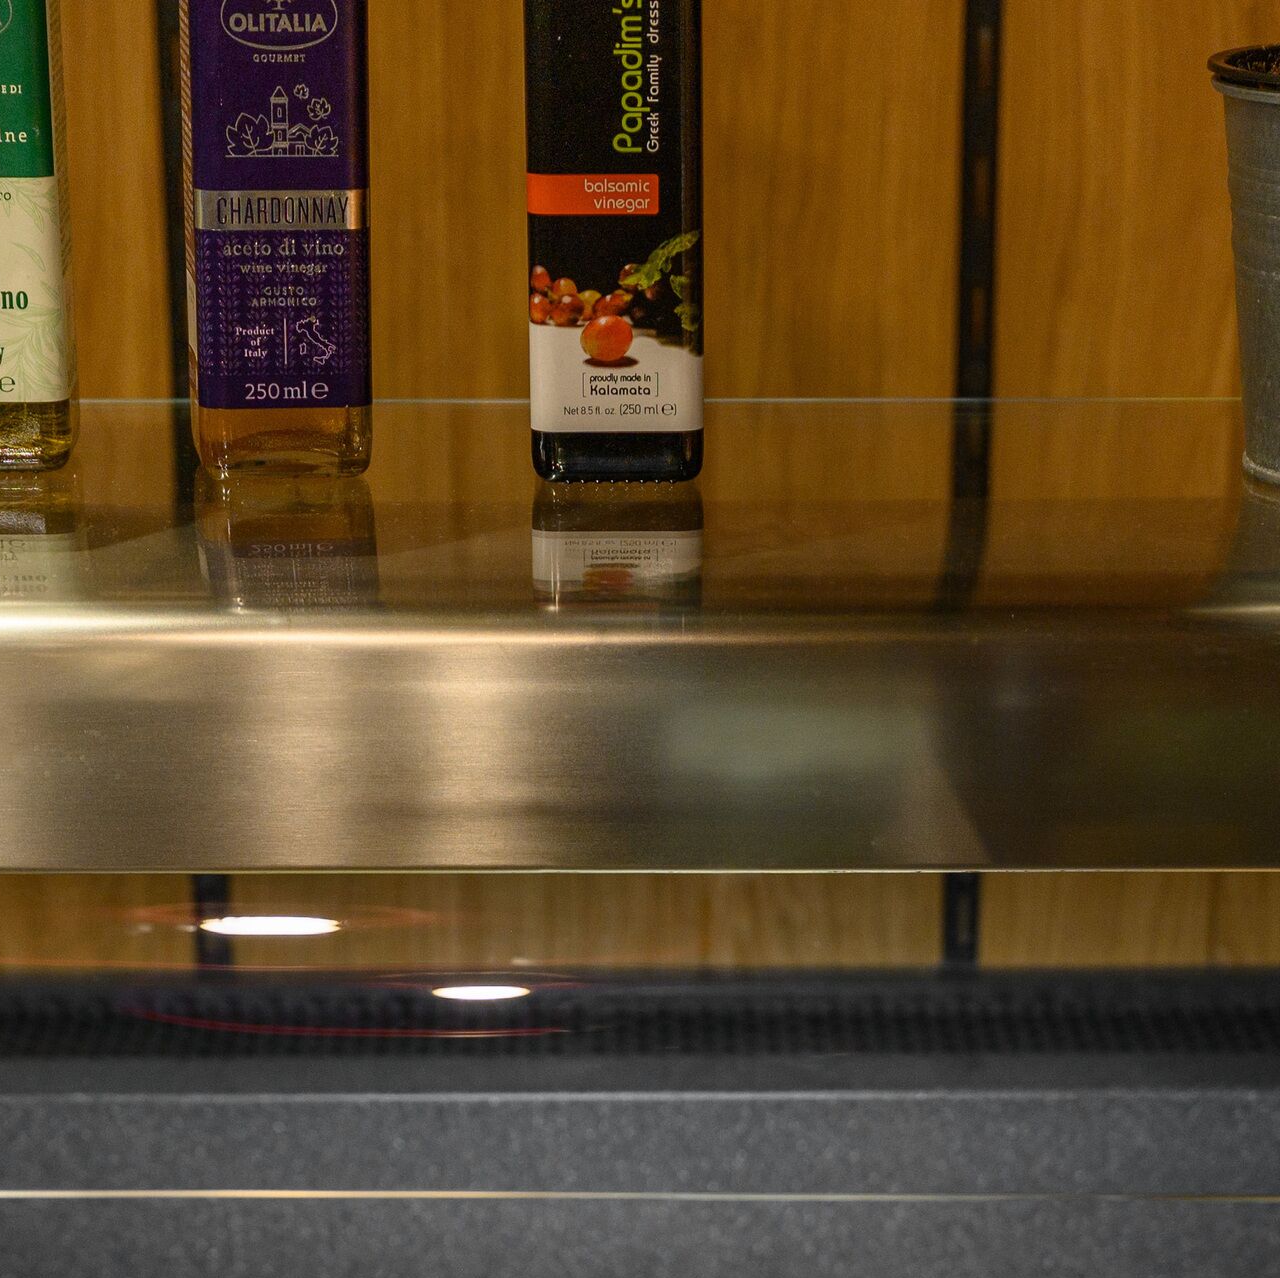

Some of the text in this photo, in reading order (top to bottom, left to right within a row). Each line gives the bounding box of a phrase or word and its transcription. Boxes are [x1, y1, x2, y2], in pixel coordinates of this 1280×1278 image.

[229, 13, 328, 33] OLITALIA
[253, 54, 306, 63] GOURMET
[612, 0, 650, 153] Papadim's
[647, 55, 663, 102] family
[10, 85, 22, 94] DI
[647, 113, 659, 153] Greek
[584, 179, 650, 193] balsamic
[594, 197, 650, 212] vinegar
[216, 197, 349, 225] CHARDONNAY
[223, 238, 345, 256] aceto di vino
[240, 263, 328, 276] wine vinegar
[263, 286, 304, 296] GUSTO
[251, 297, 317, 307] ARMONICO
[235, 327, 275, 336] Product
[250, 337, 262, 346] of
[244, 349, 268, 359] Italy
[589, 373, 651, 385] proudly made in
[245, 383, 280, 400] 250
[284, 381, 307, 400] ml
[590, 385, 651, 396] Kalamata
[563, 407, 579, 415] Net
[619, 404, 641, 416] (250
[644, 404, 659, 415] ml
